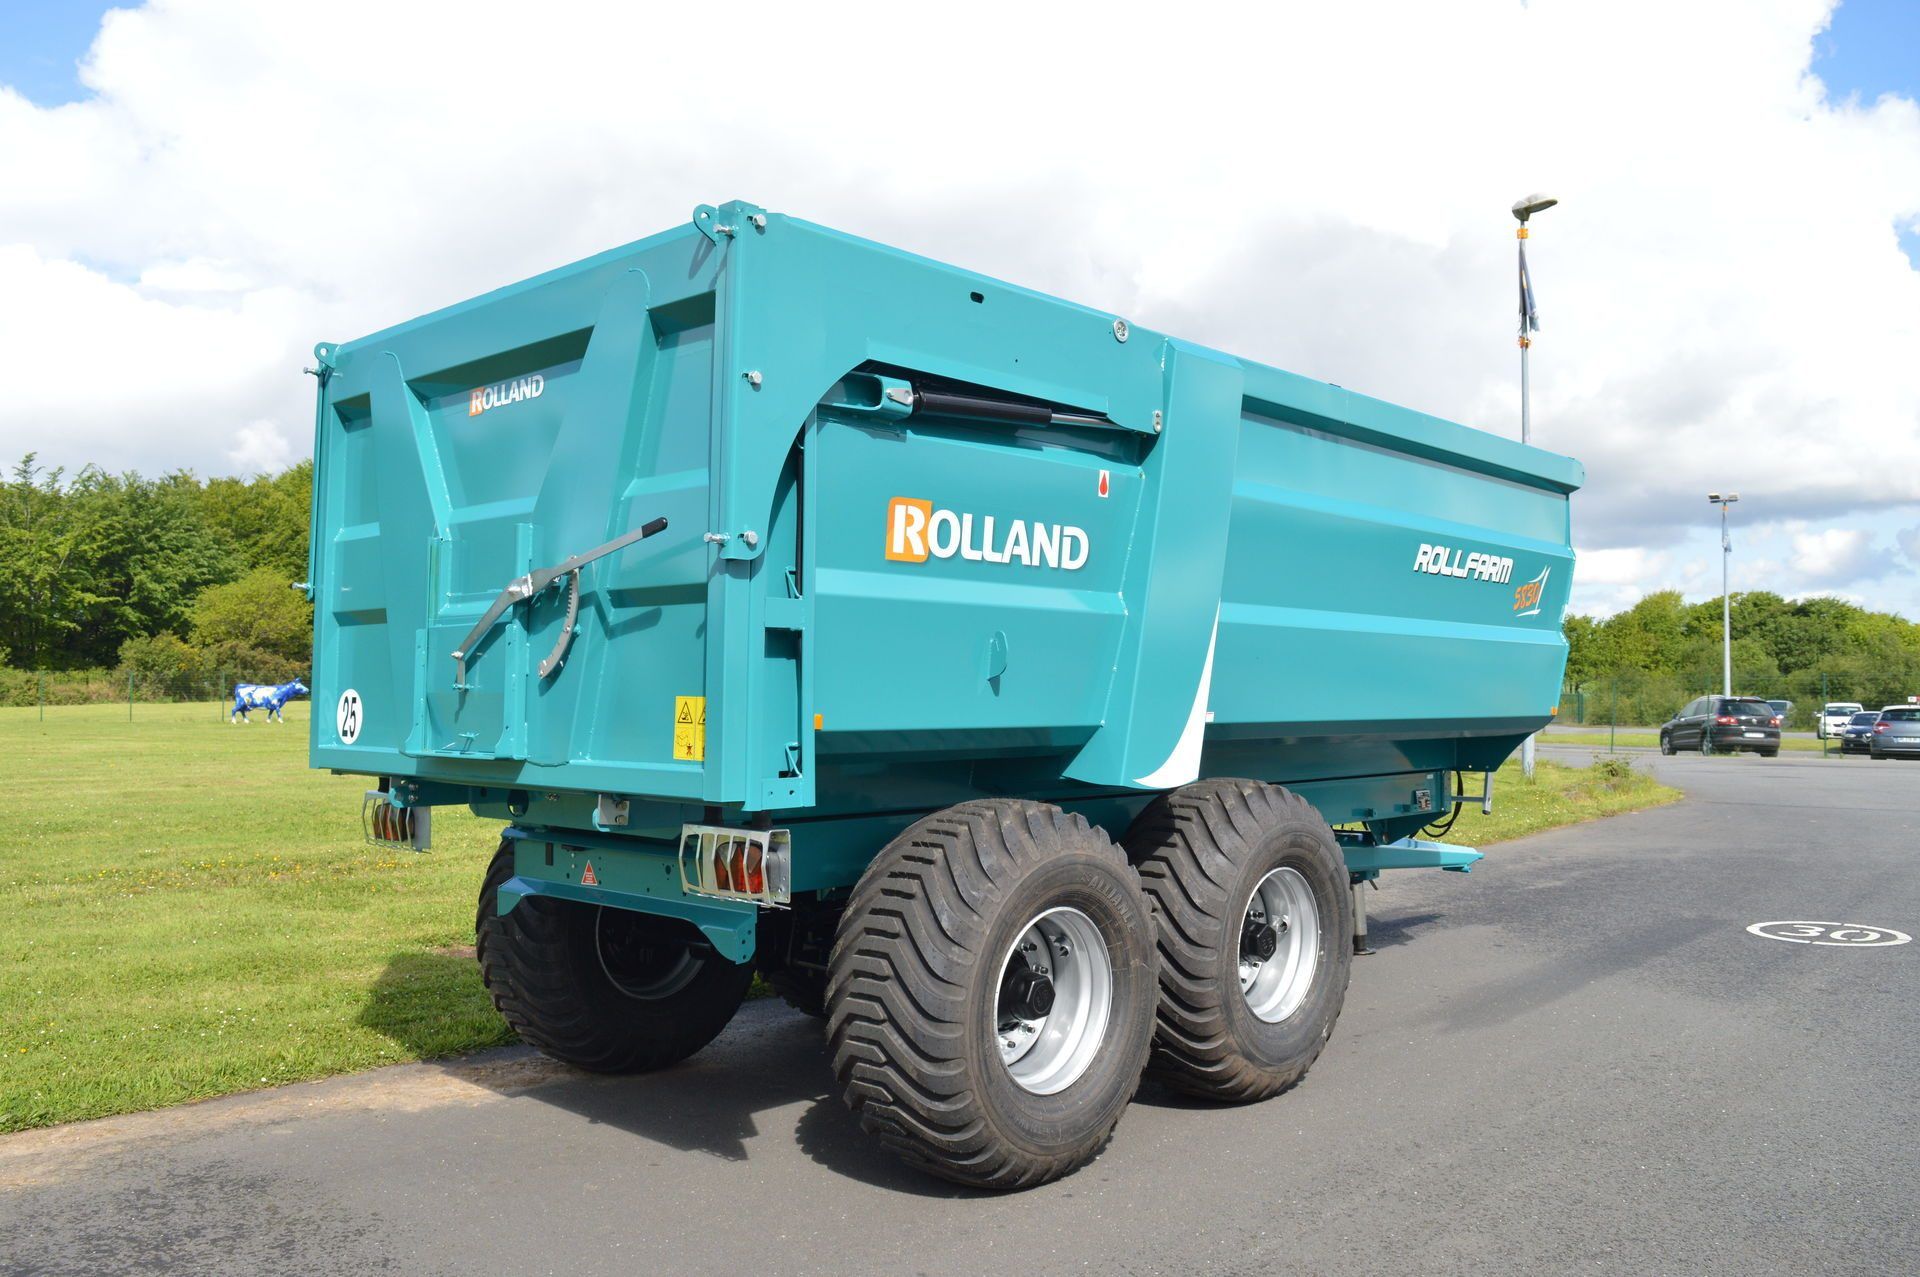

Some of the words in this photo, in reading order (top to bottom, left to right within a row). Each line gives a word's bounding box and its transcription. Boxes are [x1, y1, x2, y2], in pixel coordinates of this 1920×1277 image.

[471, 374, 545, 414] ROLLAND
[892, 503, 1090, 571] ROLLAND
[1413, 543, 1514, 584] ROLLFARM
[342, 695, 357, 738] 25
[1087, 875, 1137, 934] ALLIANCE
[1777, 924, 1881, 942] 30
